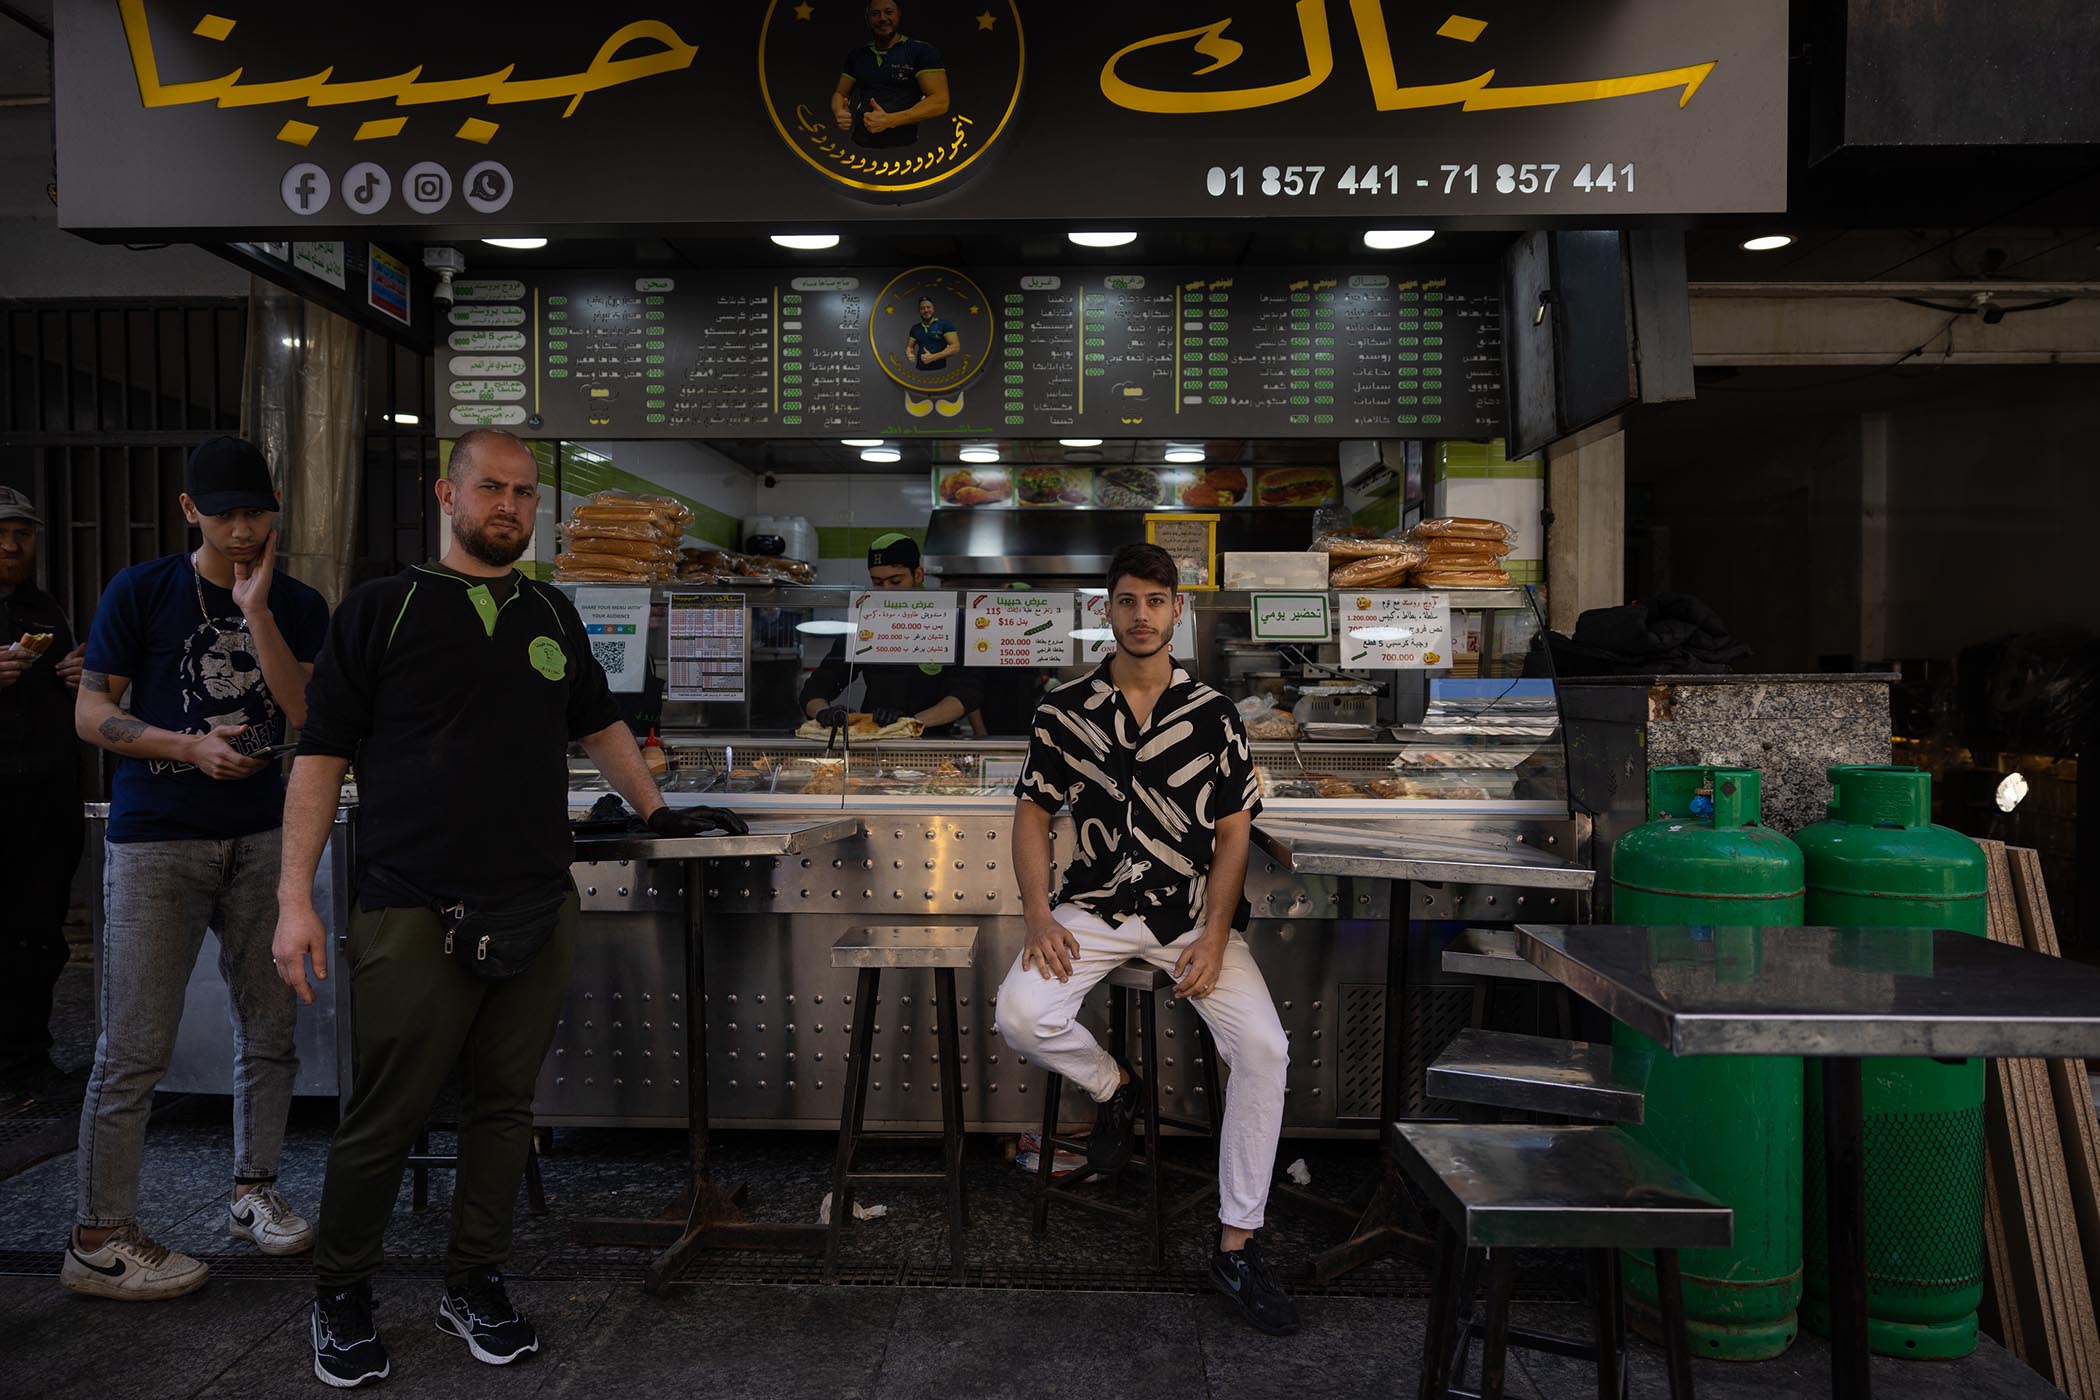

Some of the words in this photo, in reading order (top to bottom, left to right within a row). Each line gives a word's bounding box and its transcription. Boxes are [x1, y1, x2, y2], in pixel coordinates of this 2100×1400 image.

[1206, 166, 1244, 197] 01
[1261, 166, 1326, 196] 857
[1337, 165, 1398, 195] 441
[1440, 164, 1478, 194] 71
[1495, 164, 1561, 194] 857
[1572, 163, 1634, 193] 441
[884, 599, 908, 610] حبيبنا
[911, 599, 935, 610] عرض
[997, 597, 1021, 607] حبيبنا
[1025, 597, 1048, 607] عرض
[1393, 600, 1400, 610] مع
[1260, 610, 1286, 625] يومي
[1289, 607, 1321, 622] تحضير
[891, 622, 922, 630] 600.000
[1363, 639, 1376, 648] قطع
[1411, 638, 1428, 647] وجبة
[1381, 653, 1414, 661] 700.000
